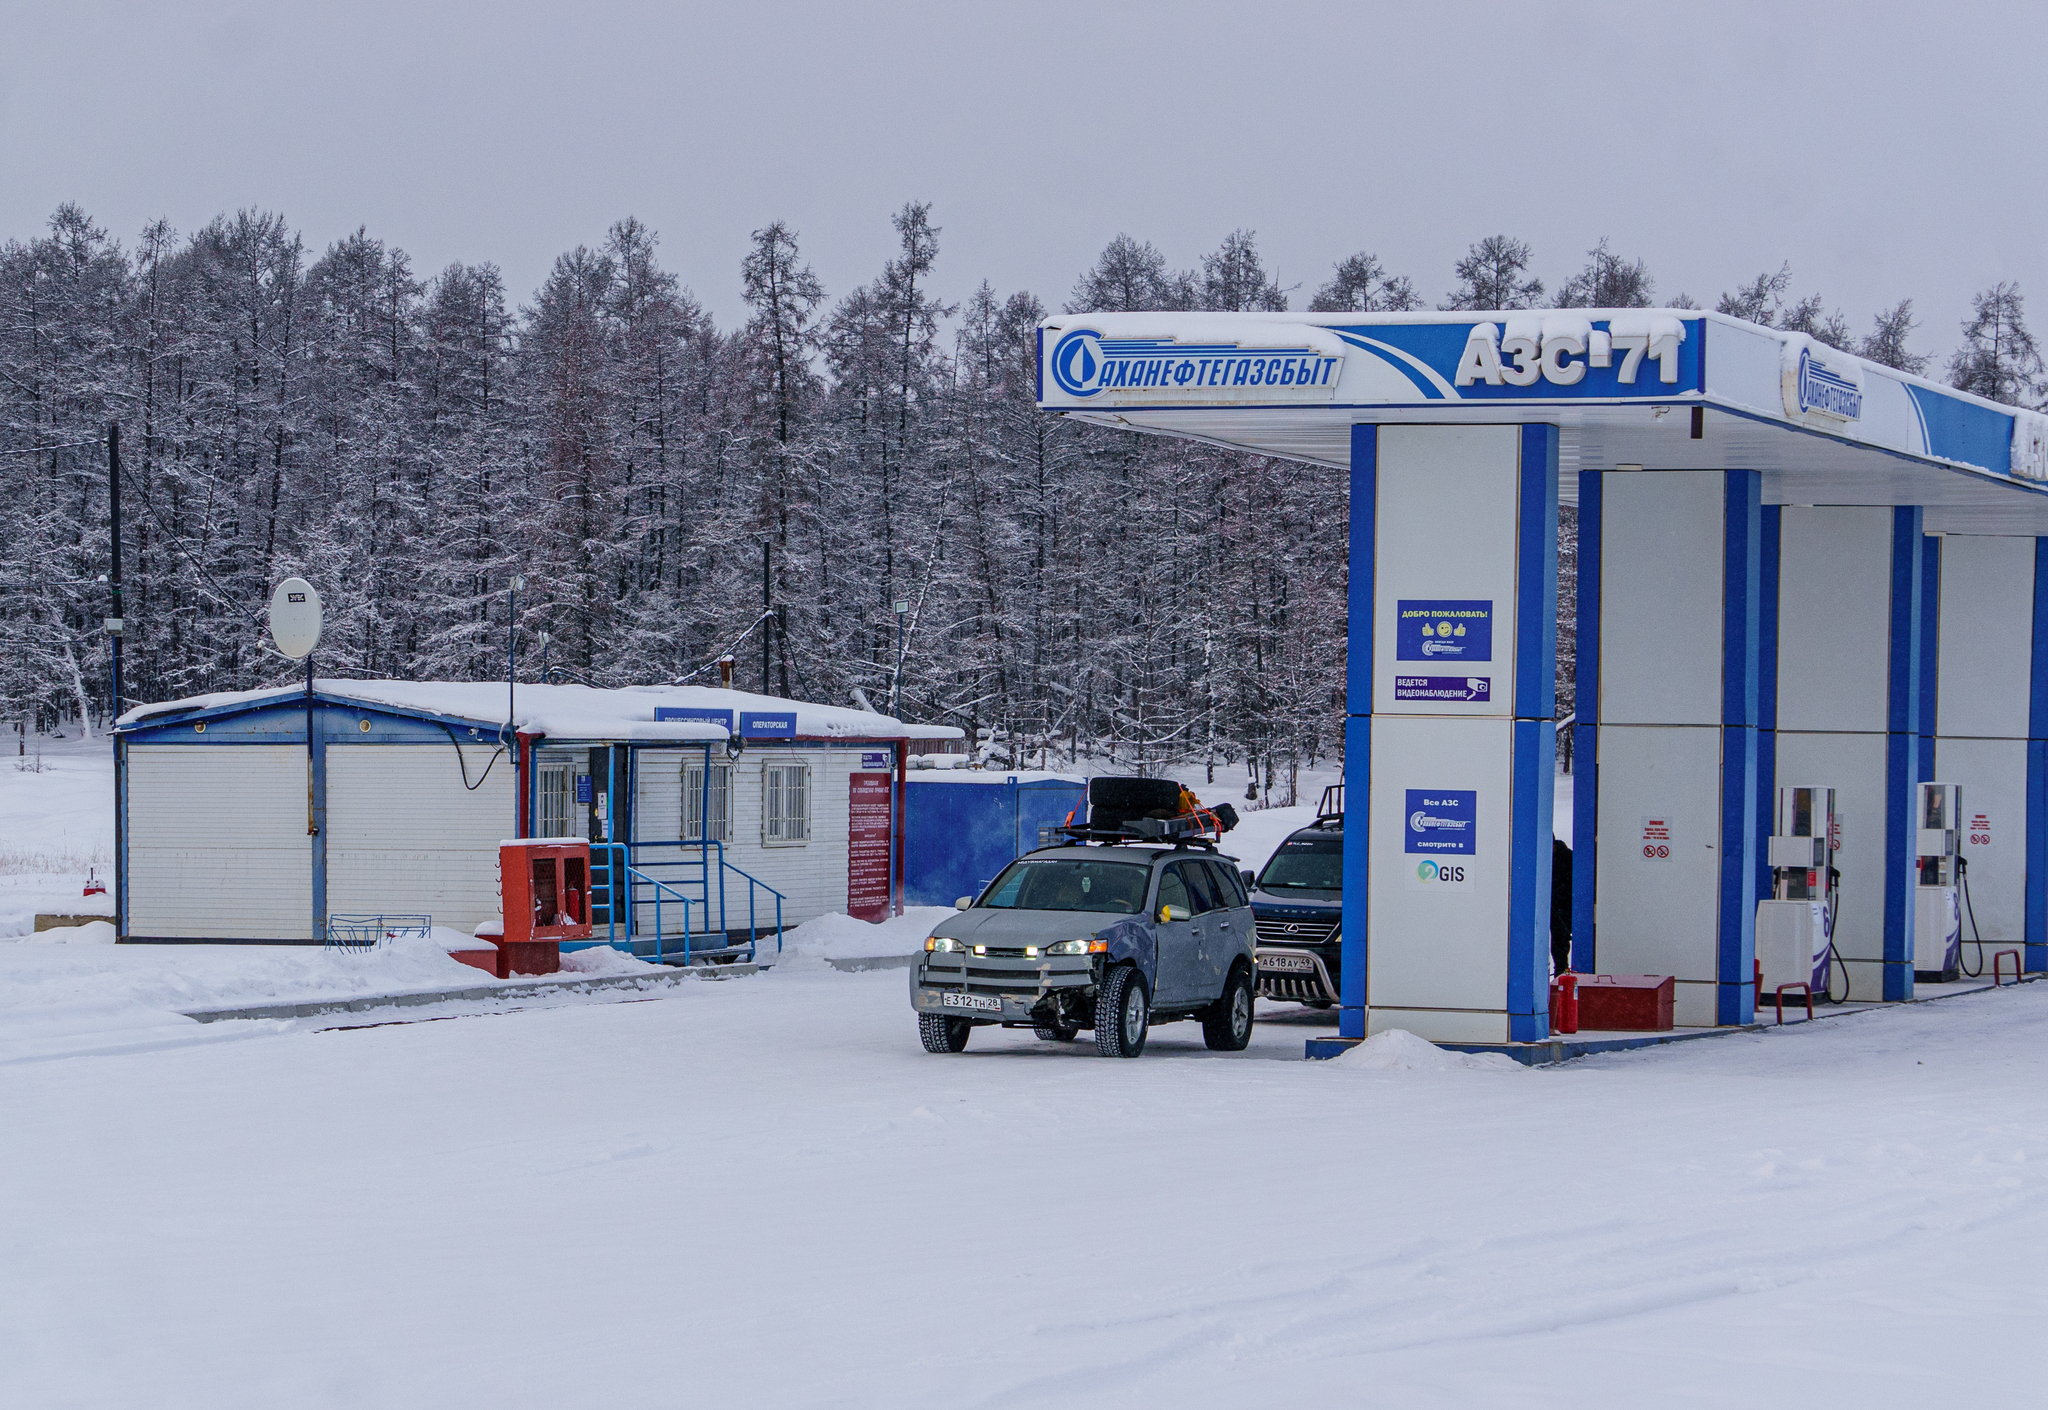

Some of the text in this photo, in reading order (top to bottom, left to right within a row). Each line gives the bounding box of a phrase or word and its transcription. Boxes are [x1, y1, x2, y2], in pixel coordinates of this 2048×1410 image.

[1455, 335, 1680, 387] АЗС-71
[1397, 679, 1428, 687] ВЕДЕТСЯ
[1397, 689, 1467, 698] ВИДЕОНАБЛЮДЕНИЕ
[752, 721, 788, 729] ОПЕРАТОРСКАЯ
[988, 998, 998, 1007] 28
